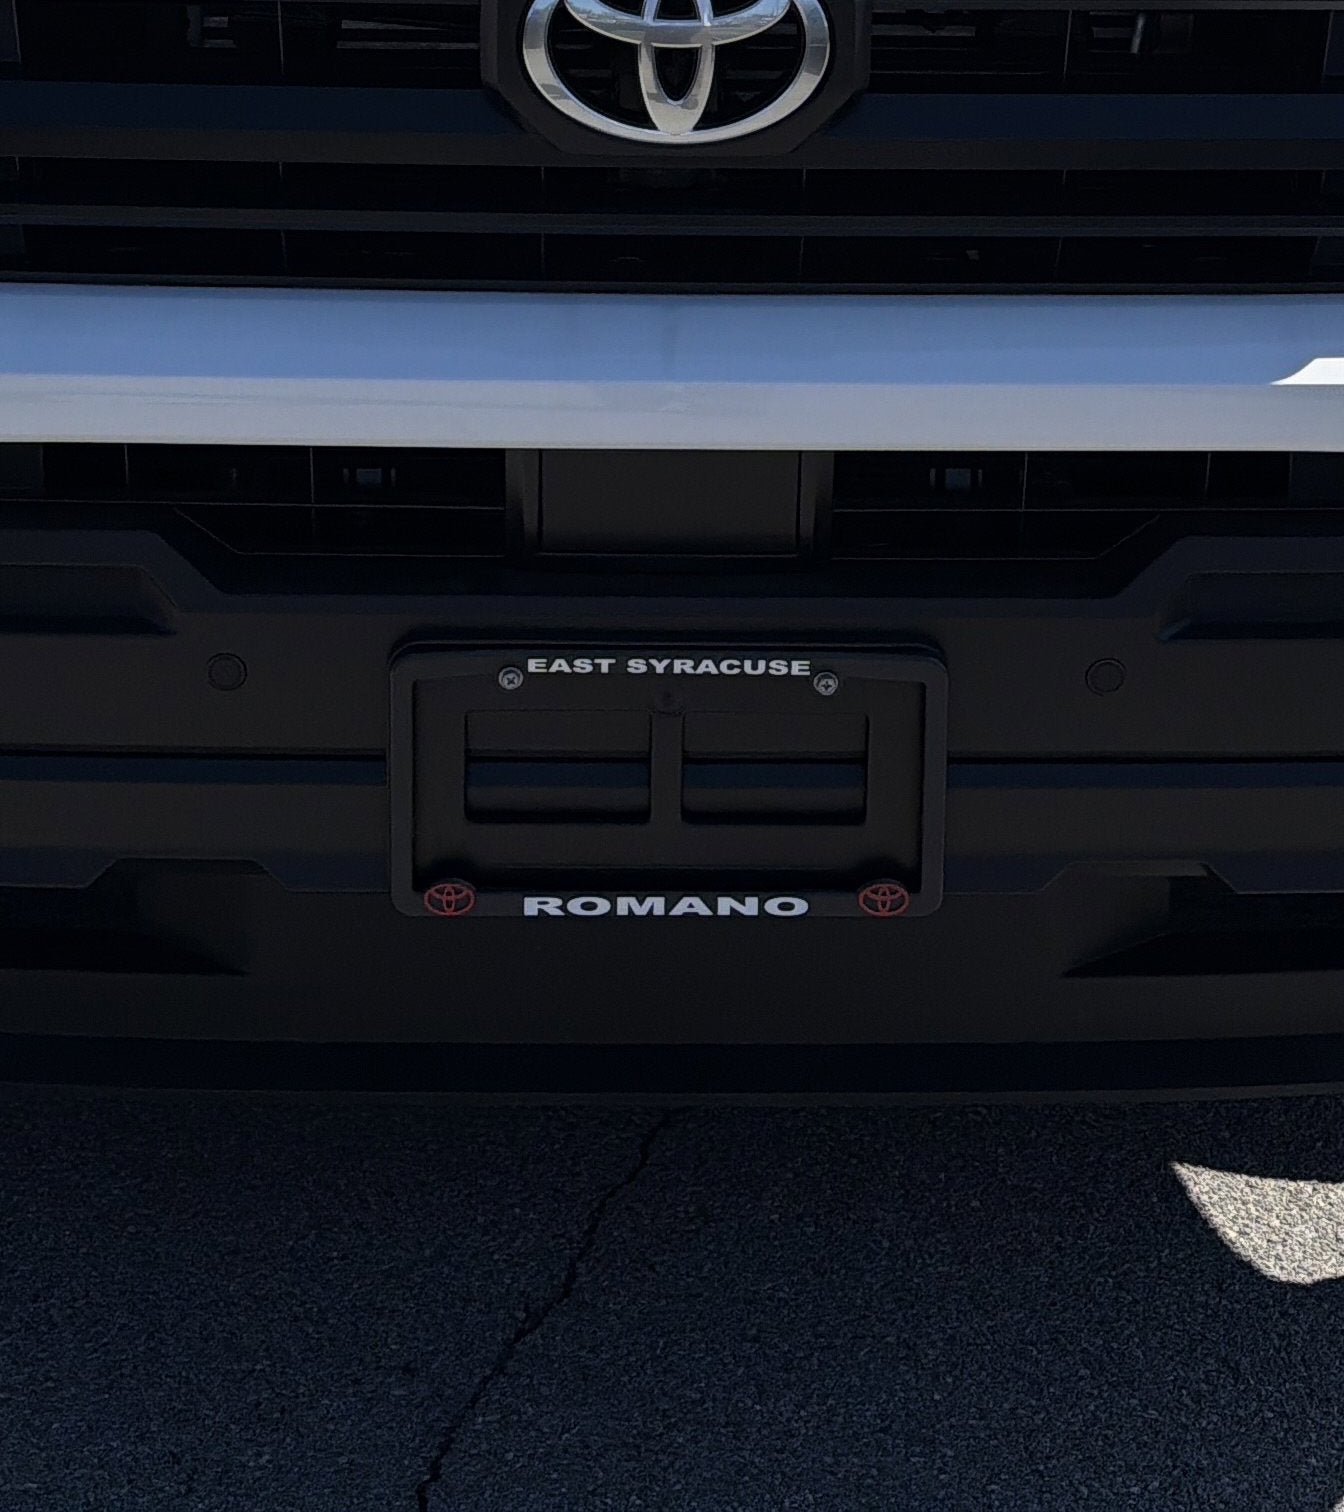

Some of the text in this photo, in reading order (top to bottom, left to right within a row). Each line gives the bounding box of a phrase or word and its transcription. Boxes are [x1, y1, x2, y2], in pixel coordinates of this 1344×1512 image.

[527, 658, 811, 675] EAST SYRACUSE
[523, 896, 809, 917] ROMANO
